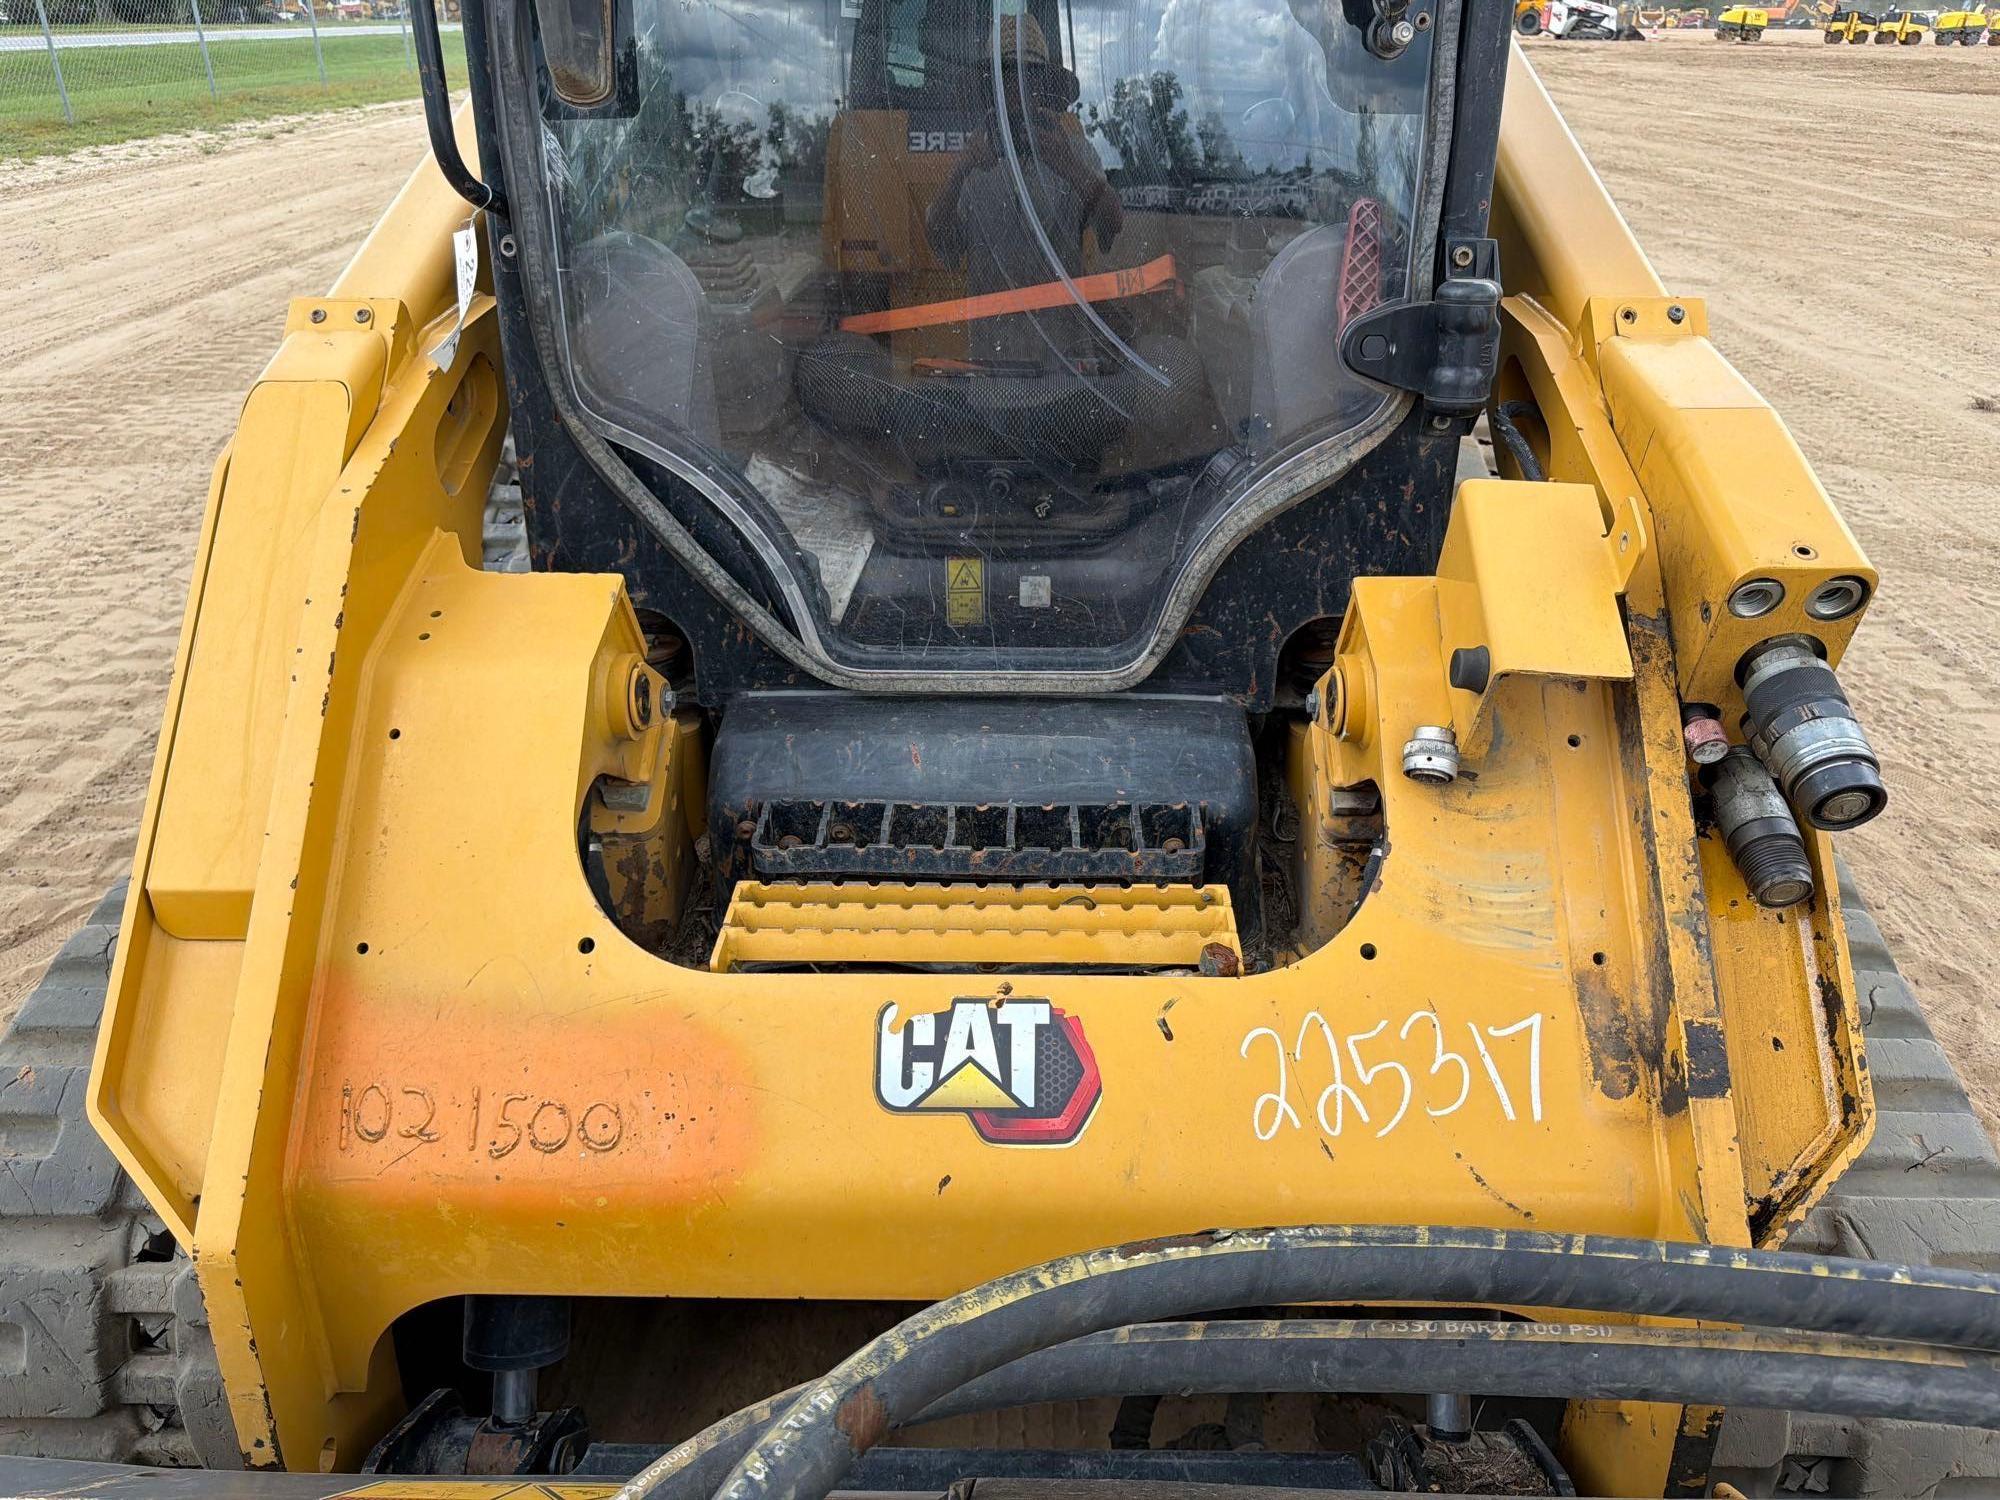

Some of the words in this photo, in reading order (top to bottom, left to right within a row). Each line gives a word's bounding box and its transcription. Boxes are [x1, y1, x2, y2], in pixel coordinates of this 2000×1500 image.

[880, 1002, 1051, 1108] CAT
[1240, 1010, 1542, 1141] 225317
[624, 1445, 692, 1497] Aeroquip
